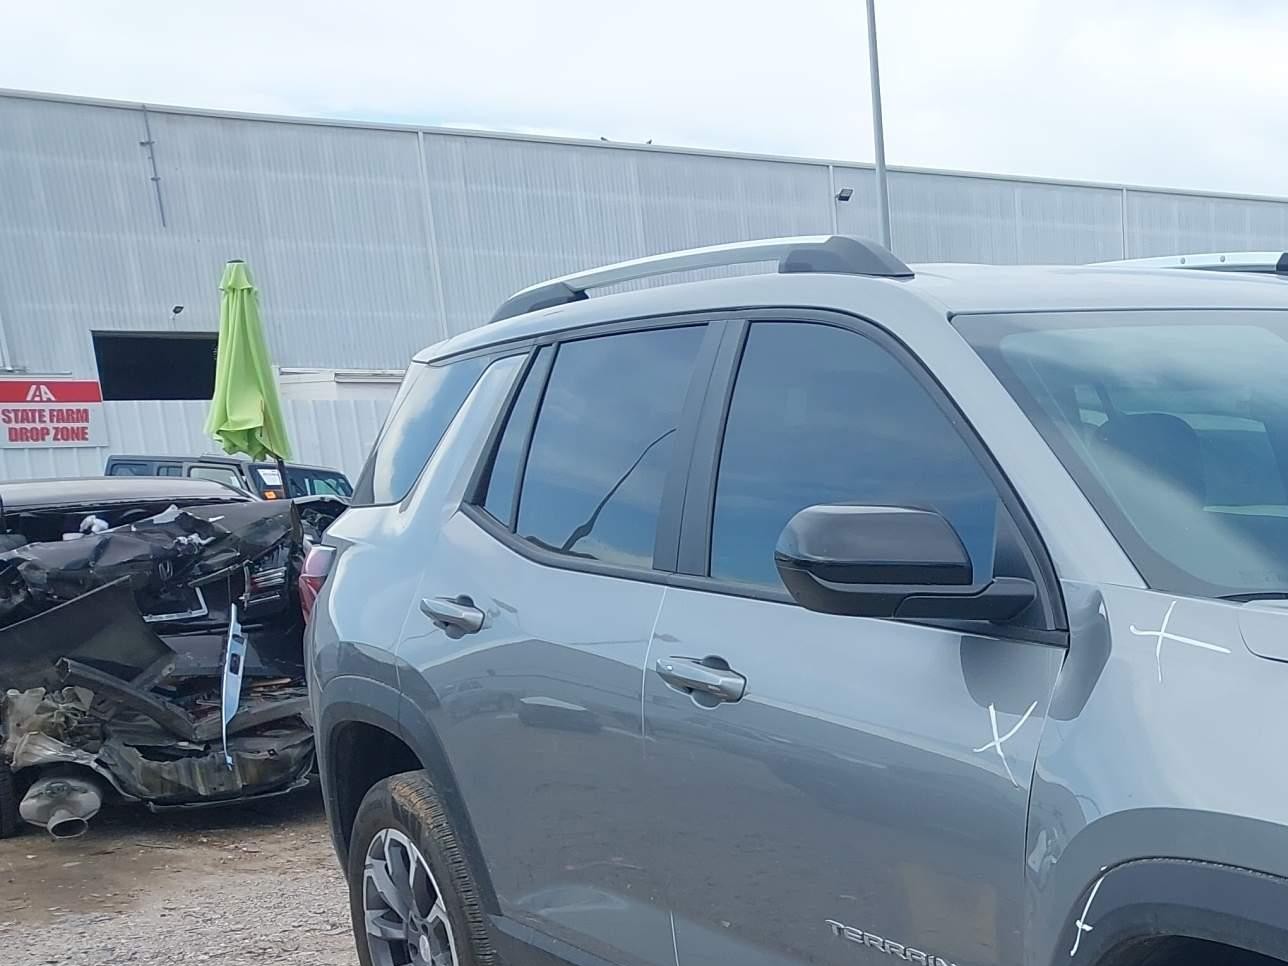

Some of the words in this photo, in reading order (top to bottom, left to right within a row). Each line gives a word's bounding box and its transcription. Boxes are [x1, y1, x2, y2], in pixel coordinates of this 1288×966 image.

[1, 408, 47, 424] STATE
[49, 408, 90, 424] FARM
[8, 426, 50, 442] DROP
[52, 426, 89, 442] ZONE
